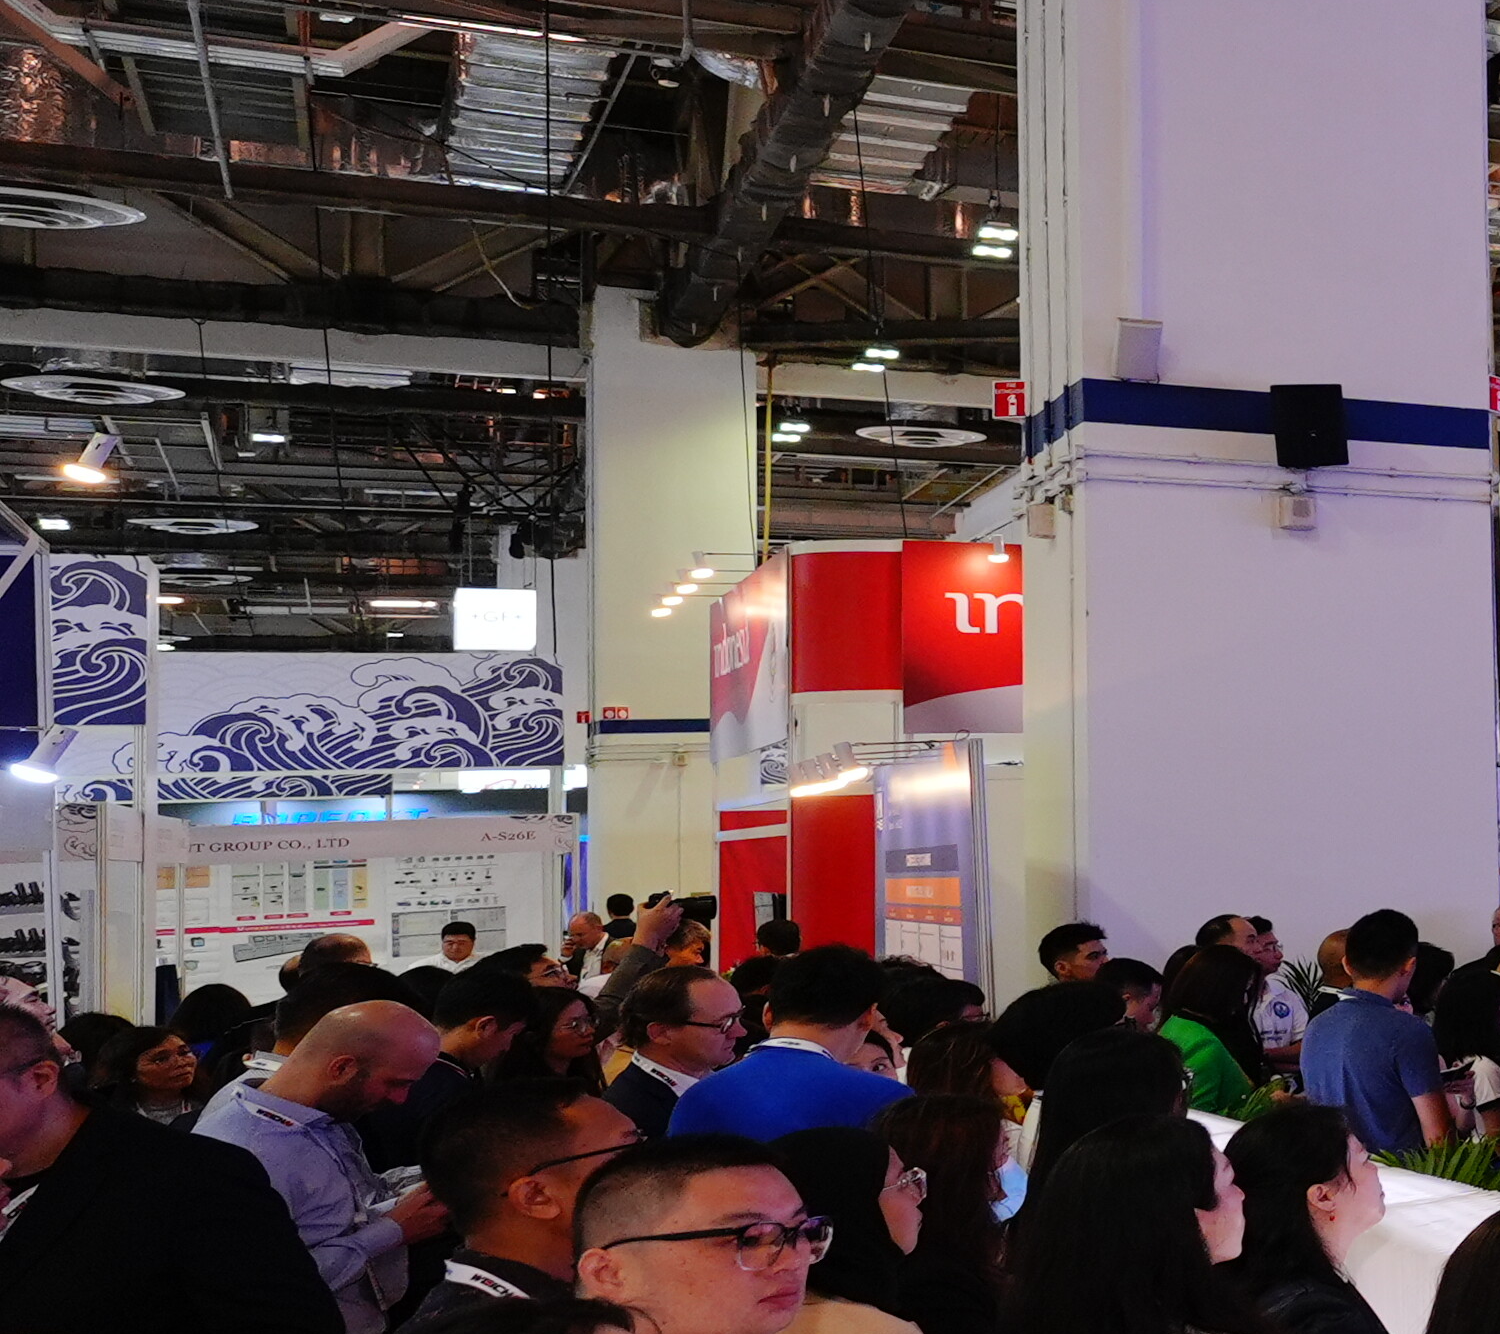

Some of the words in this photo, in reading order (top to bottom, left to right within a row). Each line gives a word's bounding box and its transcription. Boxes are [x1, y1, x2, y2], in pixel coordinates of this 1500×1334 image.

[480, 831, 537, 843] A-S26E
[189, 842, 206, 854] T
[209, 841, 273, 853] GROUP
[316, 837, 350, 849] LTD
